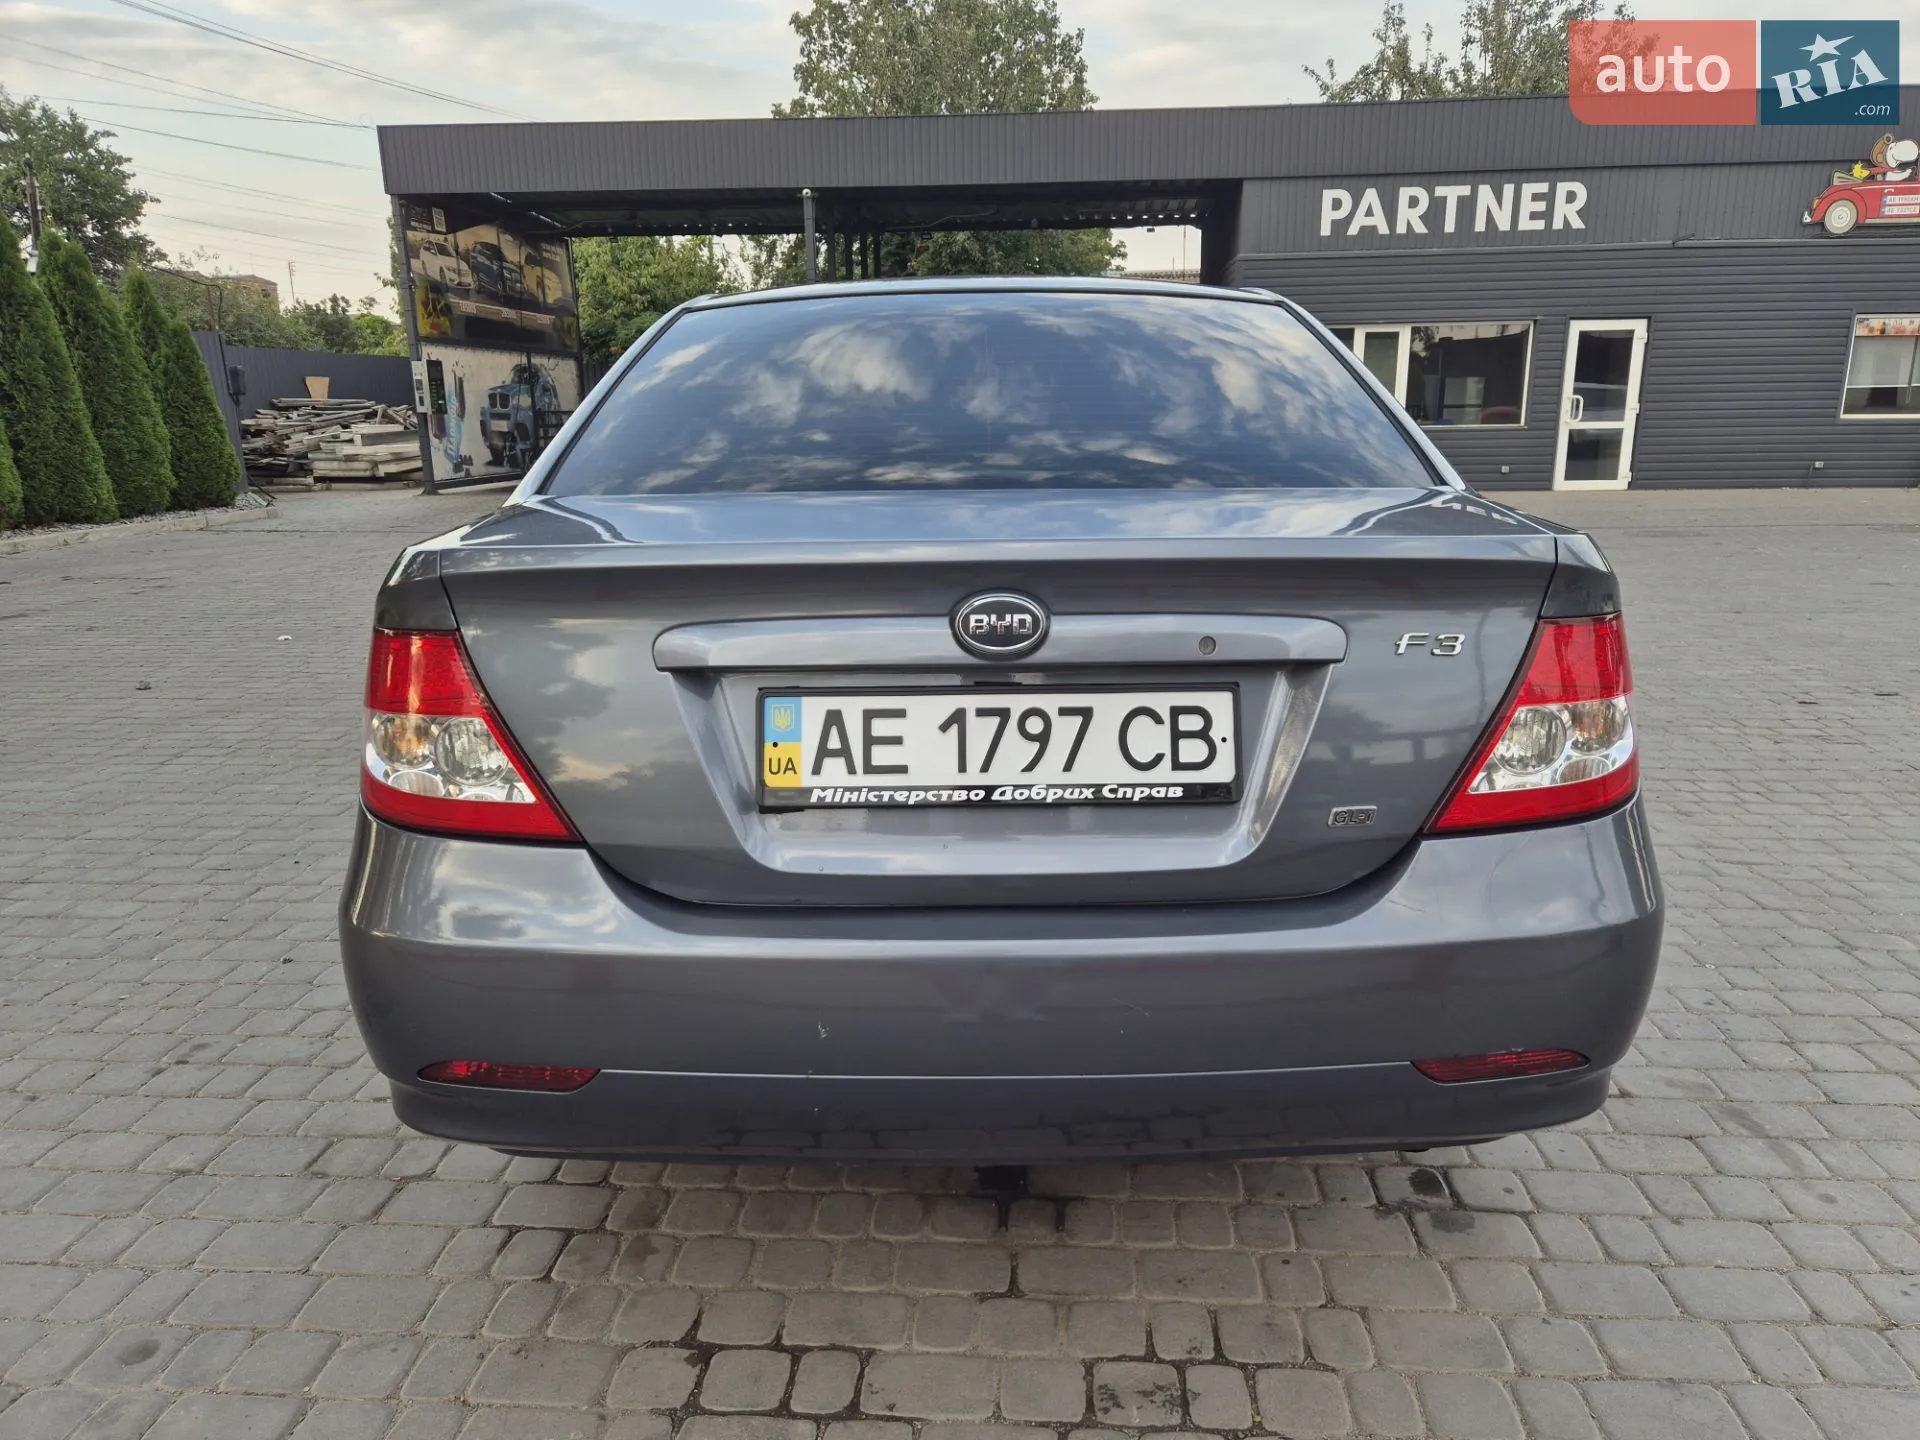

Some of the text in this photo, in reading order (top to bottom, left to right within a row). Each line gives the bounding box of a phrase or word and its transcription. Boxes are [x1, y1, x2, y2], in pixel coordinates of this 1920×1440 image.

[1320, 181, 1588, 236] PARTNER
[969, 614, 1033, 635] BYD
[1395, 632, 1467, 656] F3
[811, 705, 1218, 776] AE 1797 CB
[767, 757, 798, 776] UA
[810, 783, 1185, 805] Міністерство Добрих Справ
